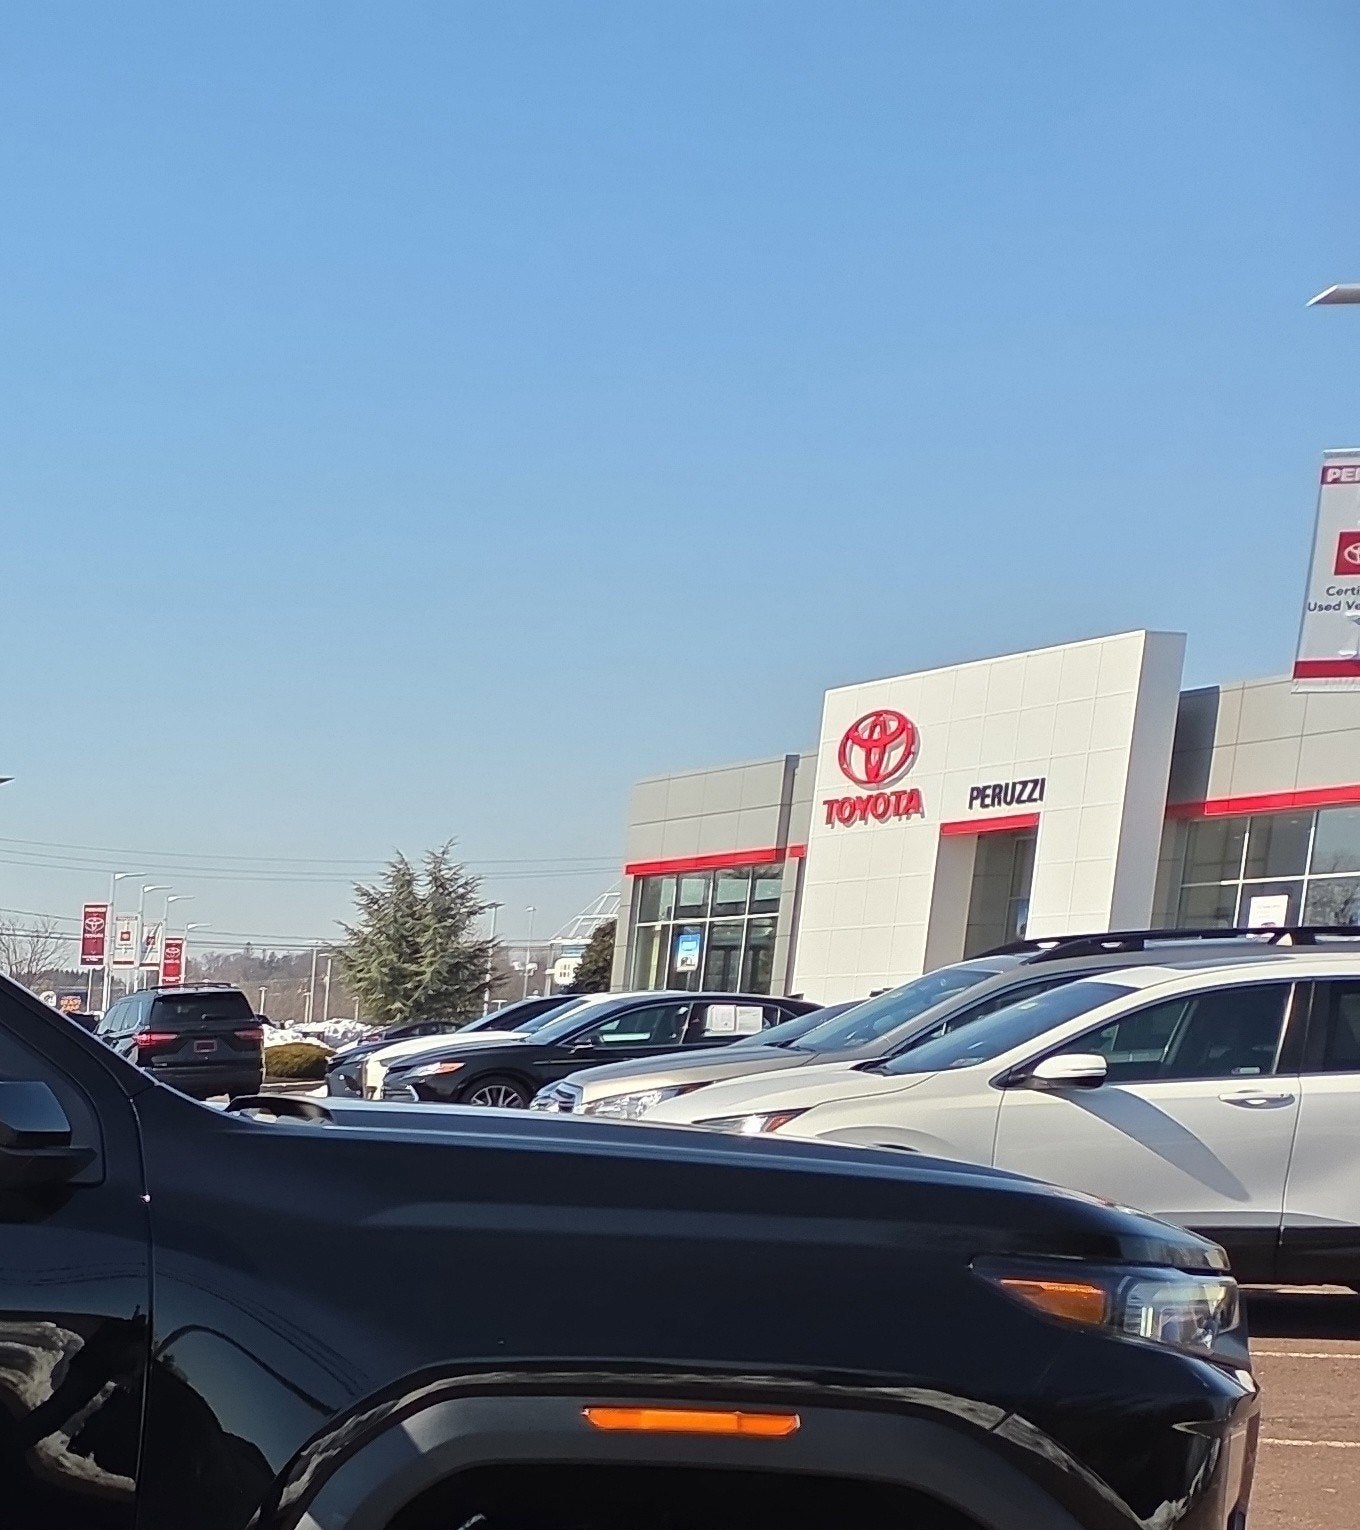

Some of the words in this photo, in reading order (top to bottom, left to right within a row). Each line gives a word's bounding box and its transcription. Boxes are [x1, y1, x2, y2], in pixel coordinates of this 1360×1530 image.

[1308, 601, 1341, 612] Used
[823, 788, 924, 826] TOYOTA
[968, 778, 1046, 810] PERUZZI
